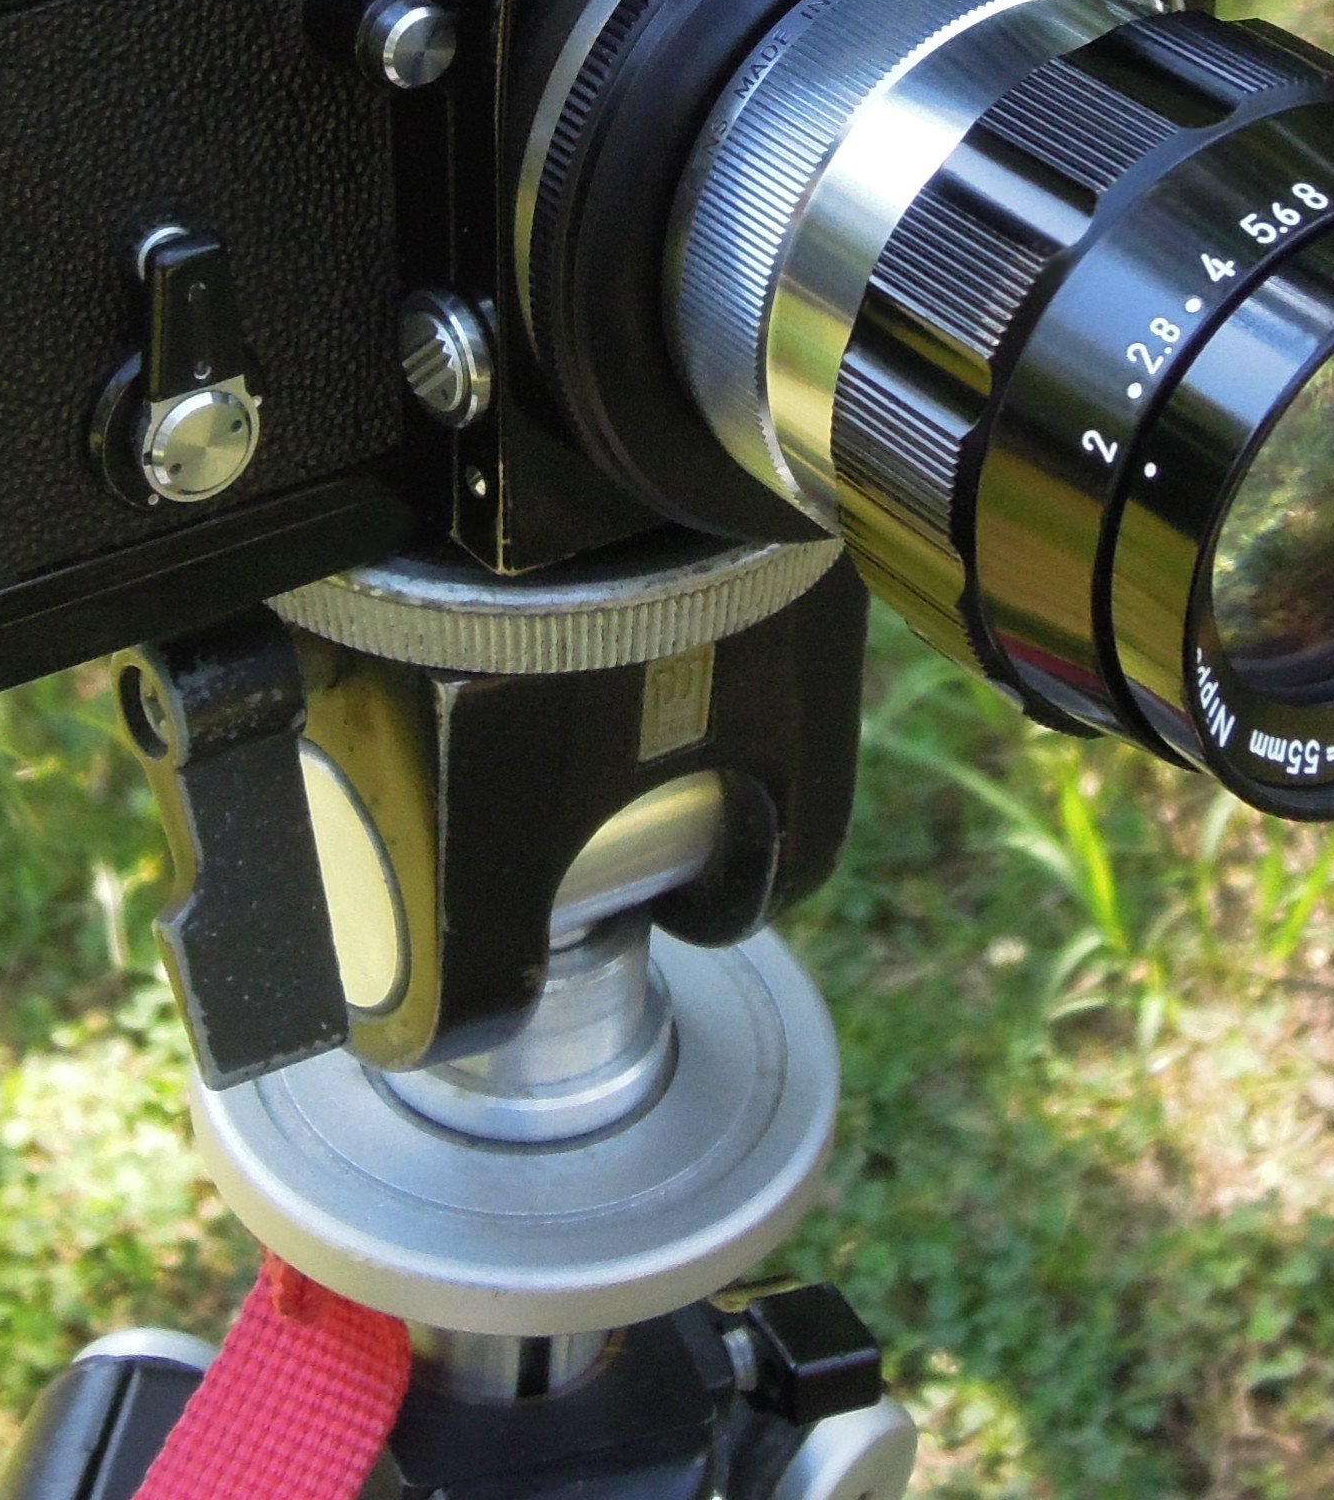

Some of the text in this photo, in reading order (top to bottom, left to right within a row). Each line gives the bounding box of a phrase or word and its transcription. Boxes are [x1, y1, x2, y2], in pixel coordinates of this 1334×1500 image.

[734, 29, 791, 100] MADE
[1081, 182, 1329, 463] 2 2.8 4 5.6 8
